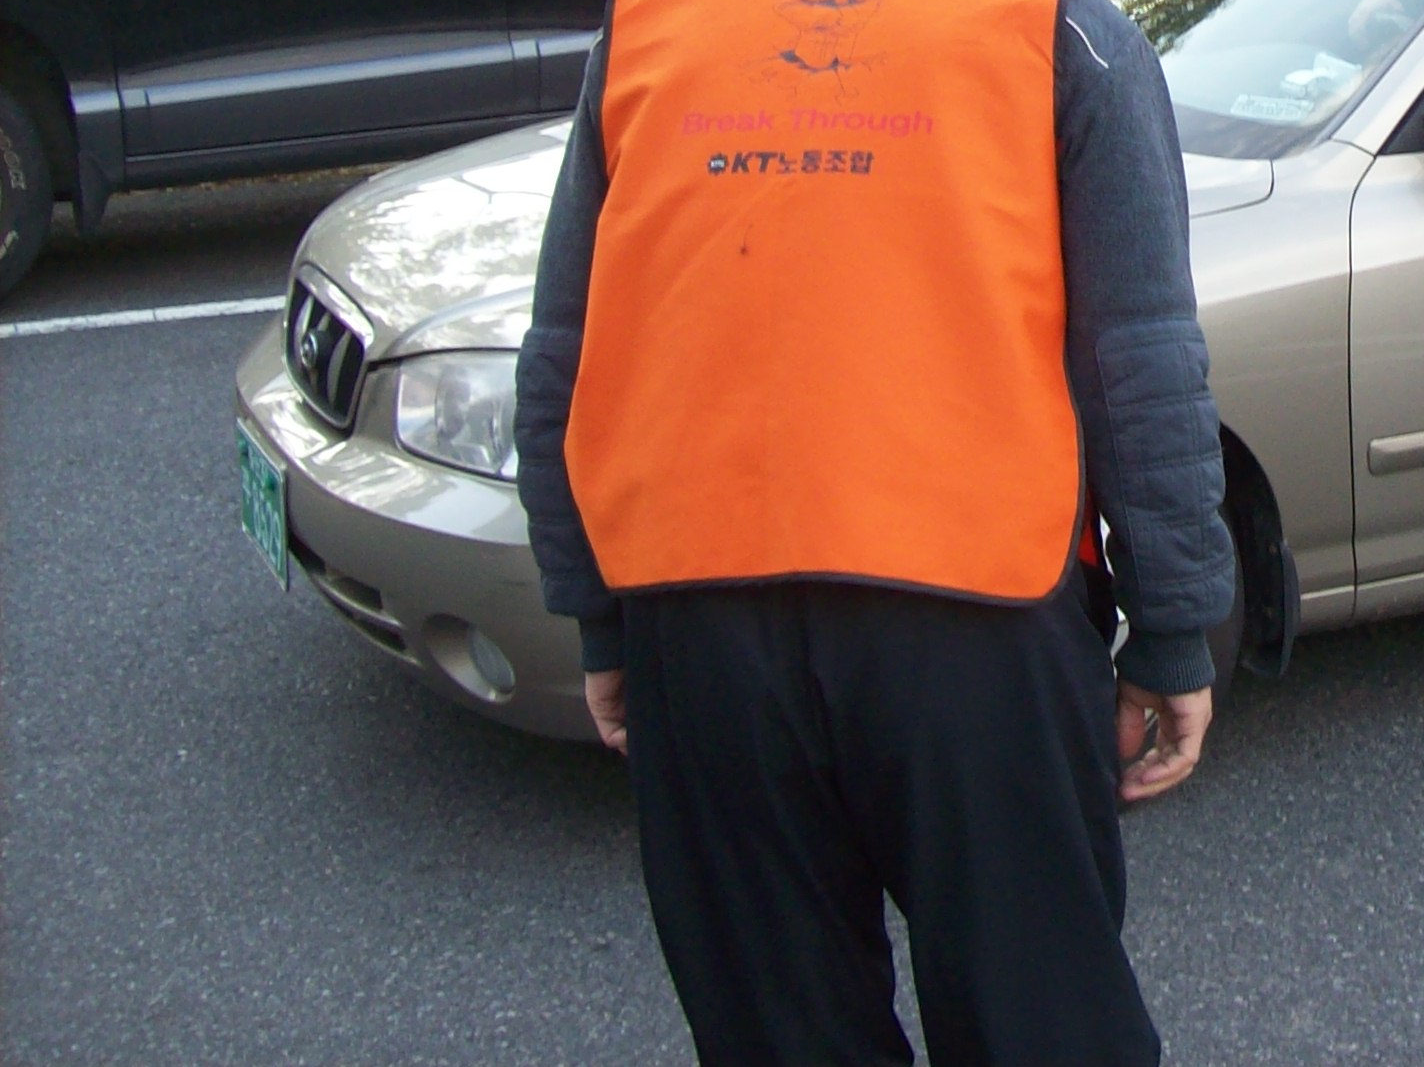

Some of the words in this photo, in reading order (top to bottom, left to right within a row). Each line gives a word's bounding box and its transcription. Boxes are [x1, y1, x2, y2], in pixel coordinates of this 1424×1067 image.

[681, 110, 774, 136] Break
[790, 108, 934, 139] Through
[731, 149, 875, 175] KT노동조합
